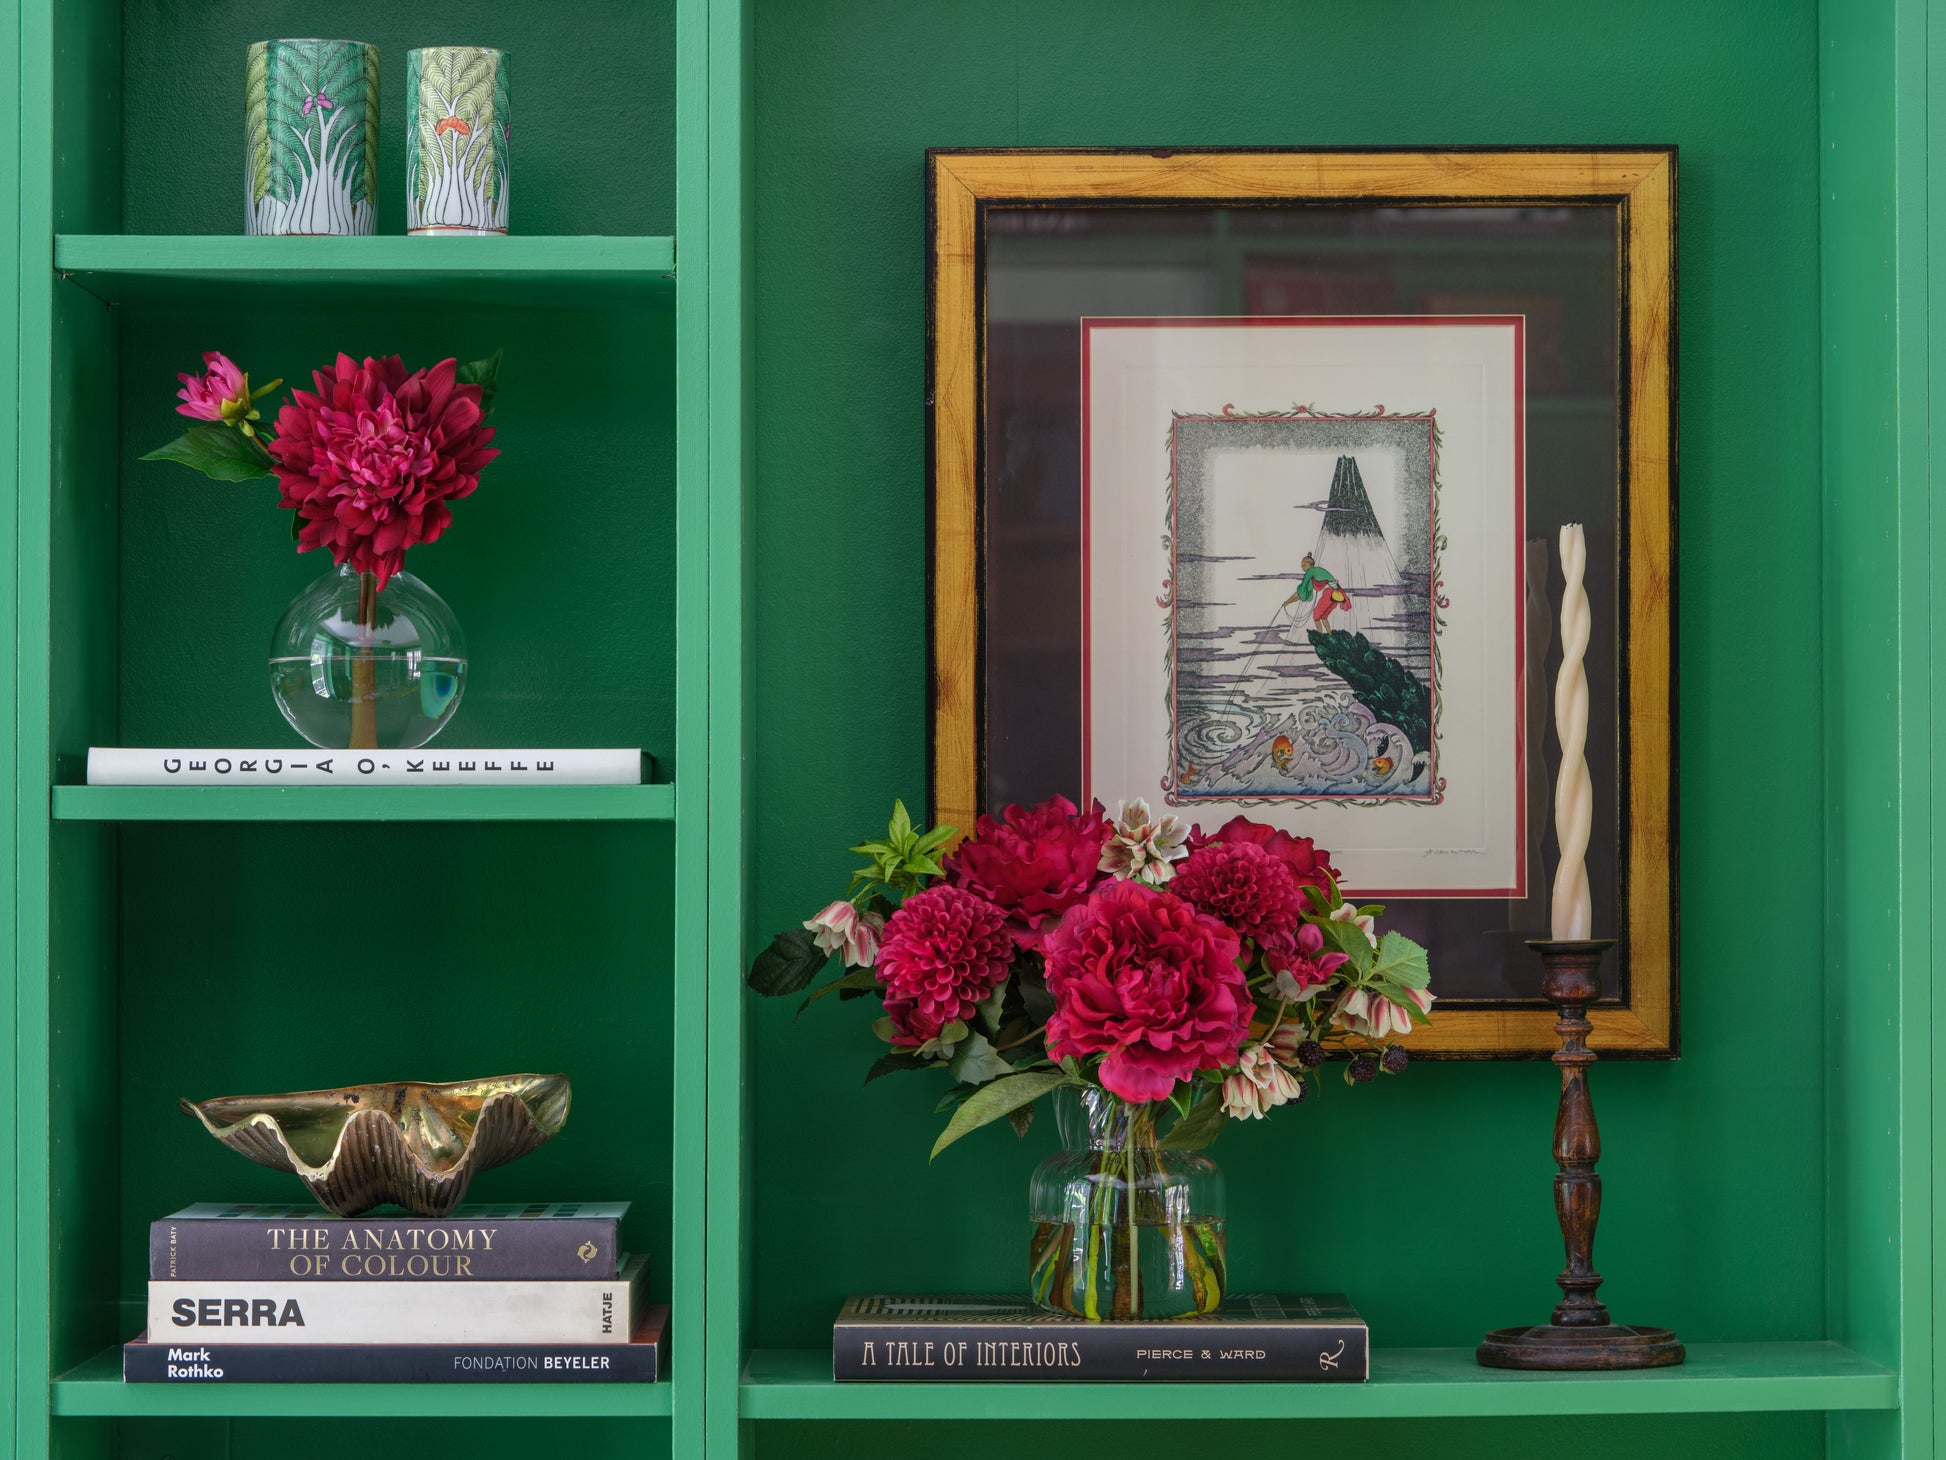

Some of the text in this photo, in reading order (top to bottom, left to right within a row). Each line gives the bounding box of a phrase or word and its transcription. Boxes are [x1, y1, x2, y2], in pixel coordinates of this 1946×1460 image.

[163, 757, 554, 775] GEORGIA O'KEEFFE
[266, 1228, 498, 1250] THE ANATOMY
[169, 1246, 177, 1278] PATRICK
[289, 1254, 475, 1277] OF COLOUR
[171, 1298, 306, 1327] SERRA
[601, 1292, 613, 1334] HATJE
[168, 1347, 211, 1362] Mark
[454, 1356, 610, 1370] FONDATION BEYELER
[861, 1341, 1082, 1367] A TALE OF INTERIORS
[1136, 1349, 1267, 1360] PIERCE & WARD
[168, 1364, 224, 1379] Rothko
